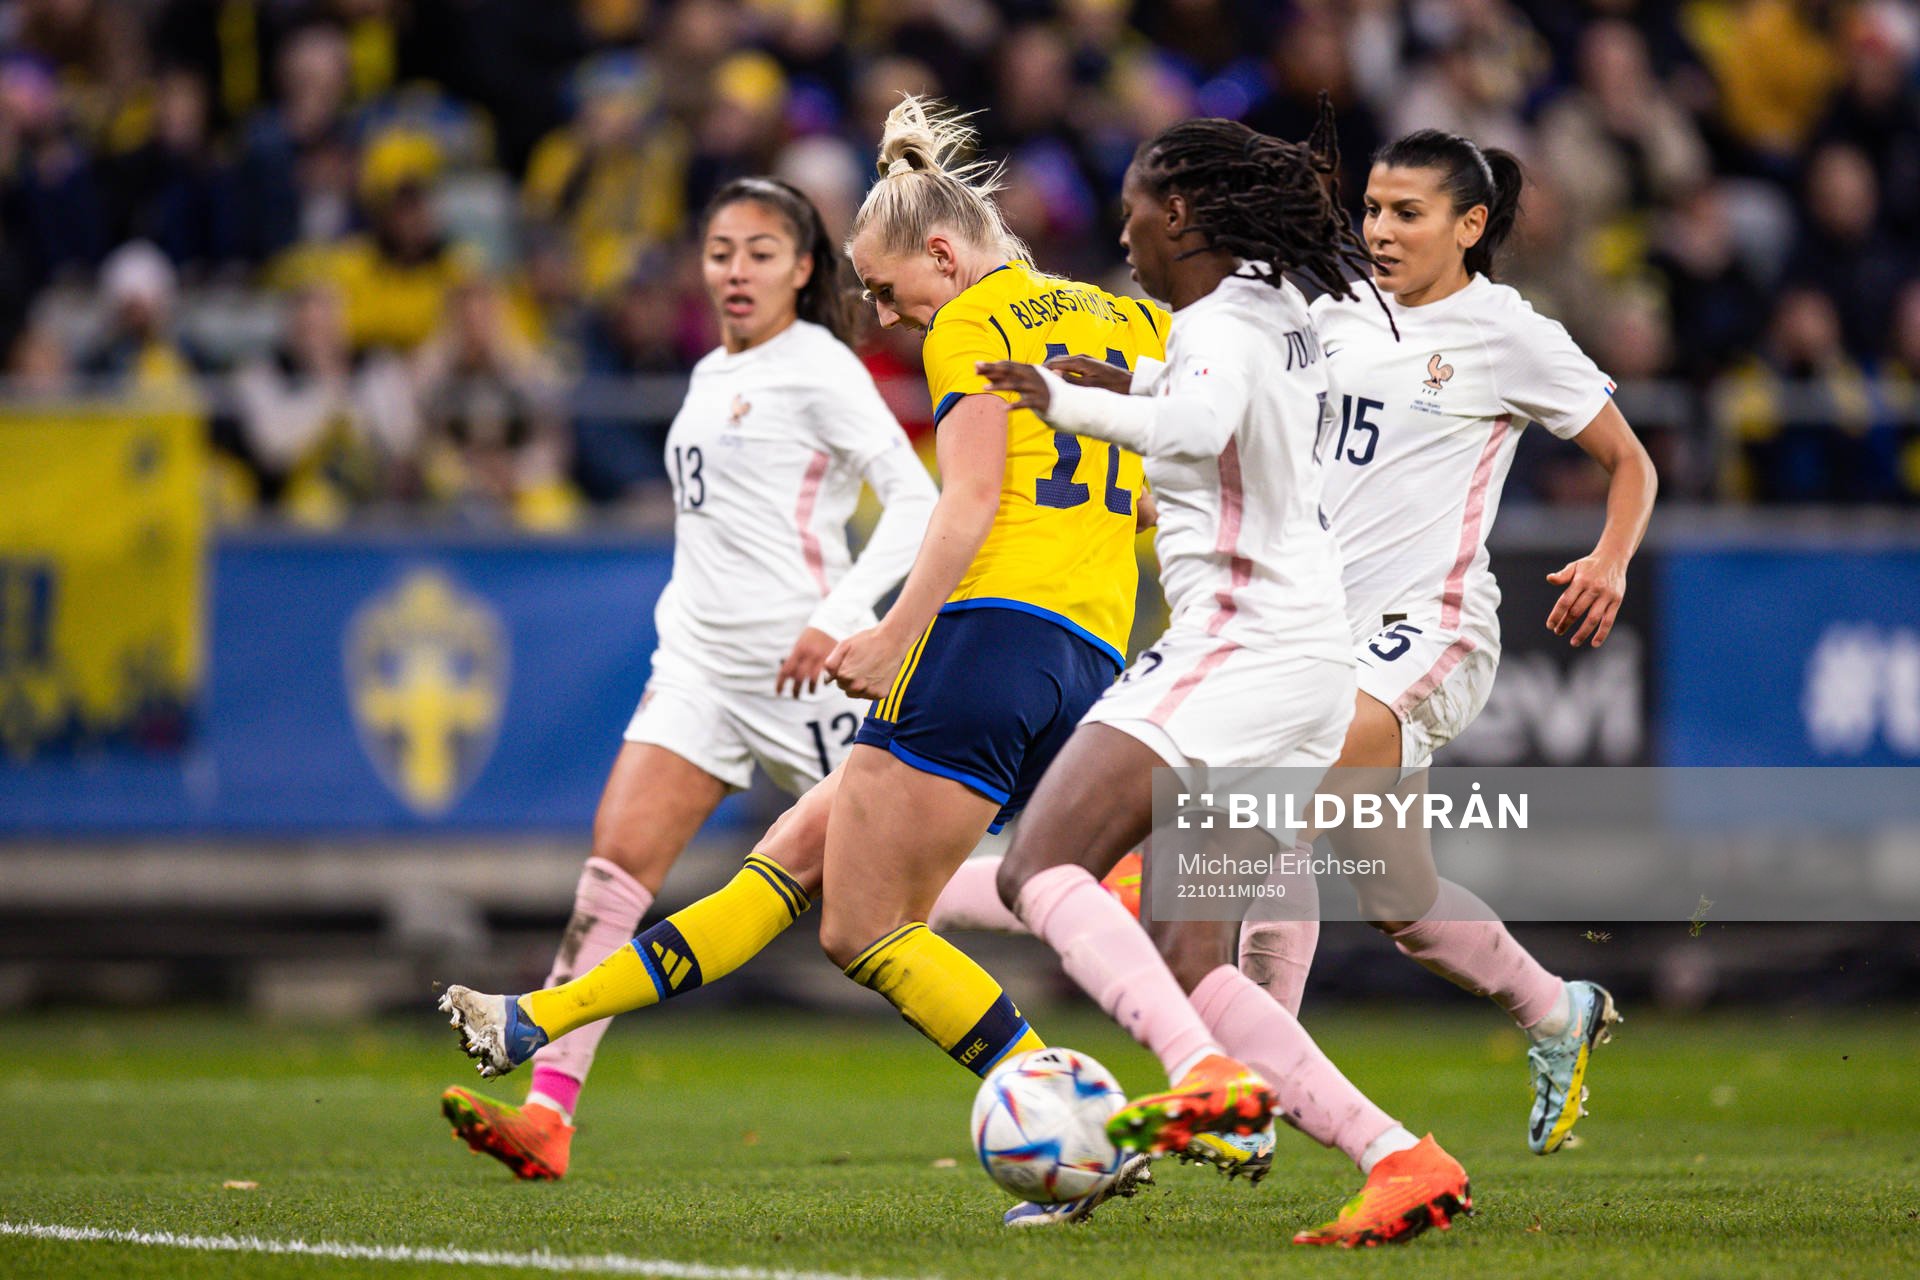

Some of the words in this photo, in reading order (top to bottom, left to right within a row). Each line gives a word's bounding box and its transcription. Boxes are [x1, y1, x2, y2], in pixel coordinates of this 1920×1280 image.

[1335, 394, 1385, 466] 15
[674, 446, 705, 509] 13
[1367, 623, 1423, 662] 5
